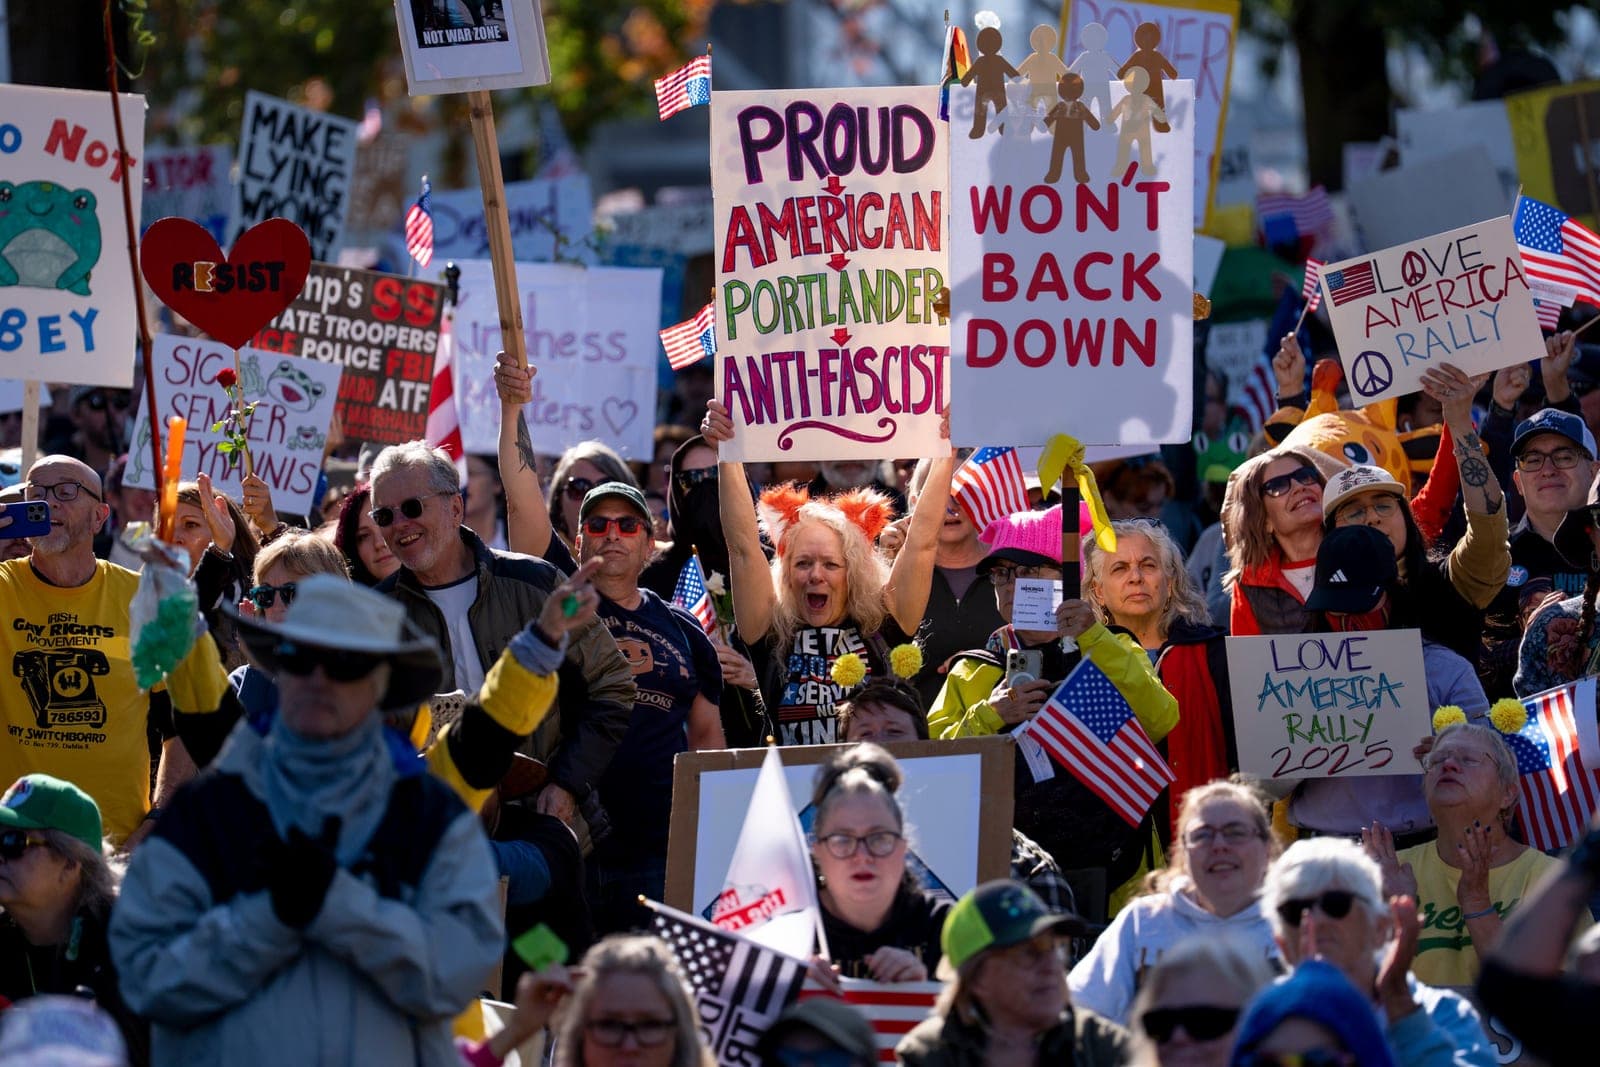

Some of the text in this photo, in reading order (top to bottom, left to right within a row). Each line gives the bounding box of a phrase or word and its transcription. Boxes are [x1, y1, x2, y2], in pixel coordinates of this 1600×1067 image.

[423, 25, 501, 45] NOT WAR ZONE
[0, 124, 22, 153] O
[252, 103, 346, 166] MAKE
[737, 100, 936, 185] PROUD
[245, 142, 345, 204] LYING
[969, 161, 1170, 235] WON'T
[722, 191, 942, 273] AMERICAN
[172, 261, 285, 292] RESIST
[982, 252, 1162, 302] BACK
[1373, 234, 1484, 294] LOVE
[371, 277, 438, 328] SS
[723, 268, 946, 341] PORTLANDER
[1366, 256, 1530, 338] AMERICA
[0, 308, 98, 354] BEY
[323, 314, 437, 354] TROOPERS
[966, 318, 1157, 368] DOWN
[1395, 303, 1501, 366] RALLY
[165, 345, 223, 387] SIC
[302, 336, 384, 371] POLICE
[385, 349, 433, 382] FBI
[338, 374, 377, 404] UARD
[378, 378, 430, 413] ATF
[724, 345, 950, 425] ANTI-FASCIST
[164, 392, 288, 444] SEMER
[13, 618, 115, 638] GAY RIGHTS
[26, 633, 100, 647] MOVEMENT
[48, 612, 78, 624] IRISH
[1270, 637, 1372, 673] LOVE
[1257, 672, 1405, 712] AMERICA
[25, 728, 107, 744] SWITCHBOARD
[50, 711, 100, 722] 786593
[780, 718, 842, 746] KIN
[1282, 713, 1374, 744] RALLY
[1271, 740, 1393, 778] 2025
